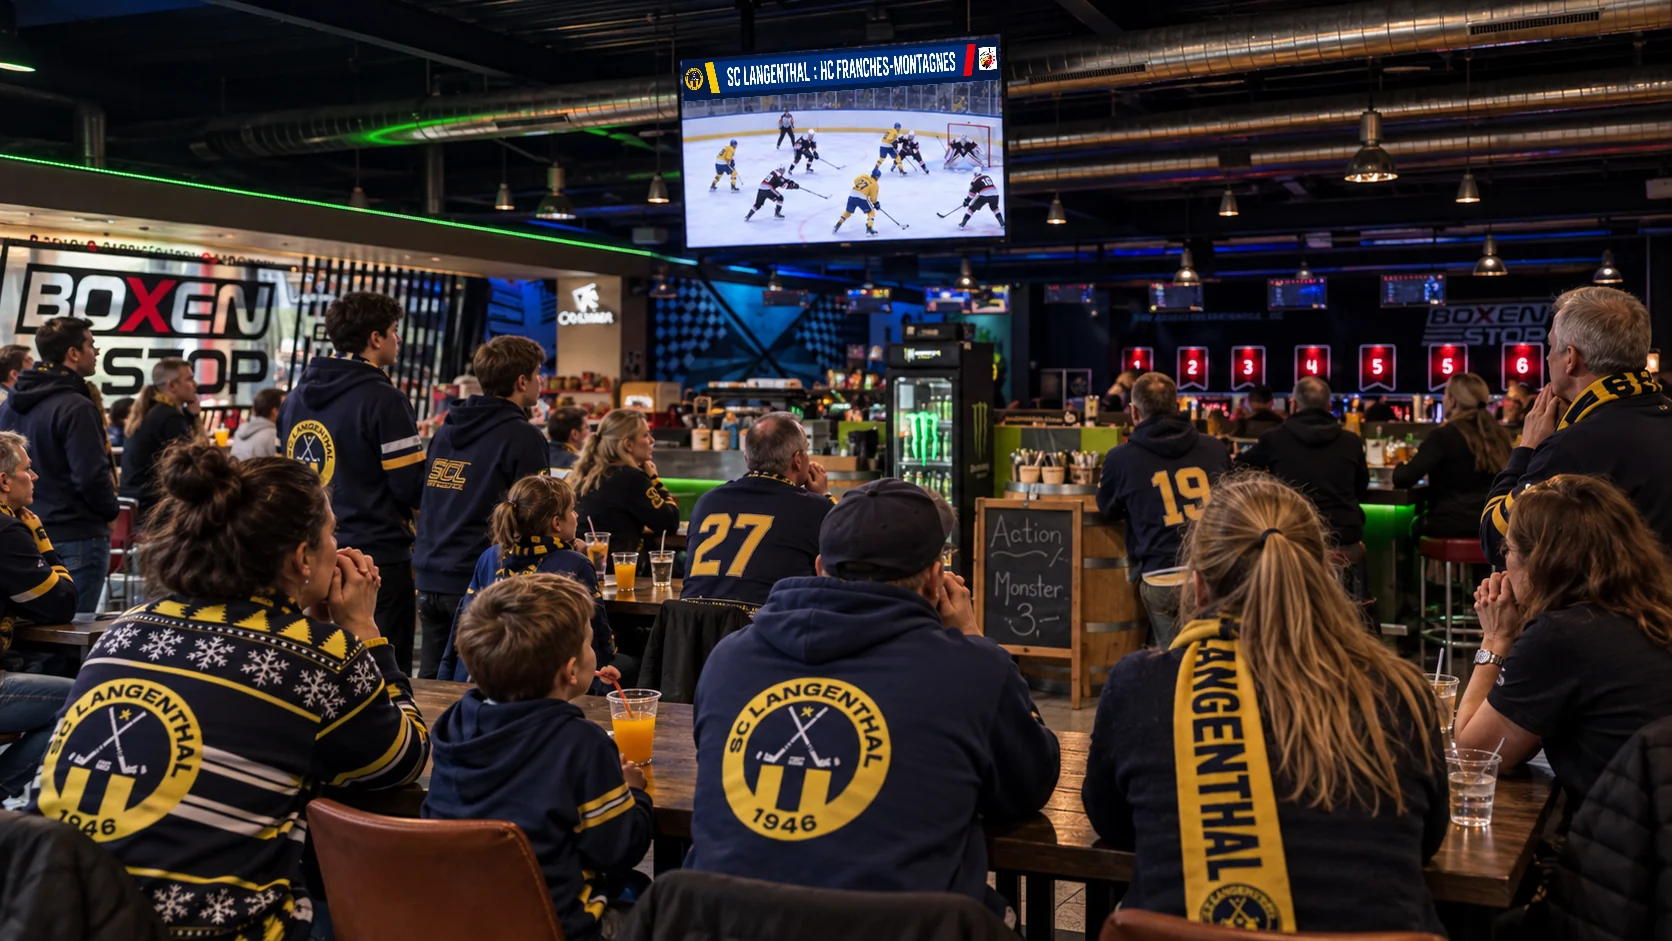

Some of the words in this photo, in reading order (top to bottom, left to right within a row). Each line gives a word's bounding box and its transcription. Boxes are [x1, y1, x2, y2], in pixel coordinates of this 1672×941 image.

[727, 66, 741, 87] SC
[743, 61, 811, 86] LANGENTHAL
[820, 59, 835, 81] HC
[836, 51, 956, 80] FRANCHES-MONTAGNES
[23, 270, 270, 335] BOXEN
[1430, 304, 1548, 325] BOXEN
[1462, 326, 1548, 346] STOP
[1187, 359, 1198, 375] 2
[1243, 359, 1254, 375] 3
[1306, 359, 1318, 374] 4
[1372, 358, 1383, 374] 5
[1442, 358, 1453, 374] 5
[1516, 357, 1529, 374] 6
[292, 422, 334, 462] LANGENTHAL
[429, 457, 472, 484] SCL
[1151, 466, 1212, 526] 19
[689, 512, 775, 577] 27
[994, 571, 1064, 606] Monster
[50, 720, 72, 755] SC
[75, 684, 195, 778] LANGENTHAL
[729, 720, 750, 754] SC
[748, 683, 883, 768] LANGENTHAL
[752, 808, 818, 834] 1946
